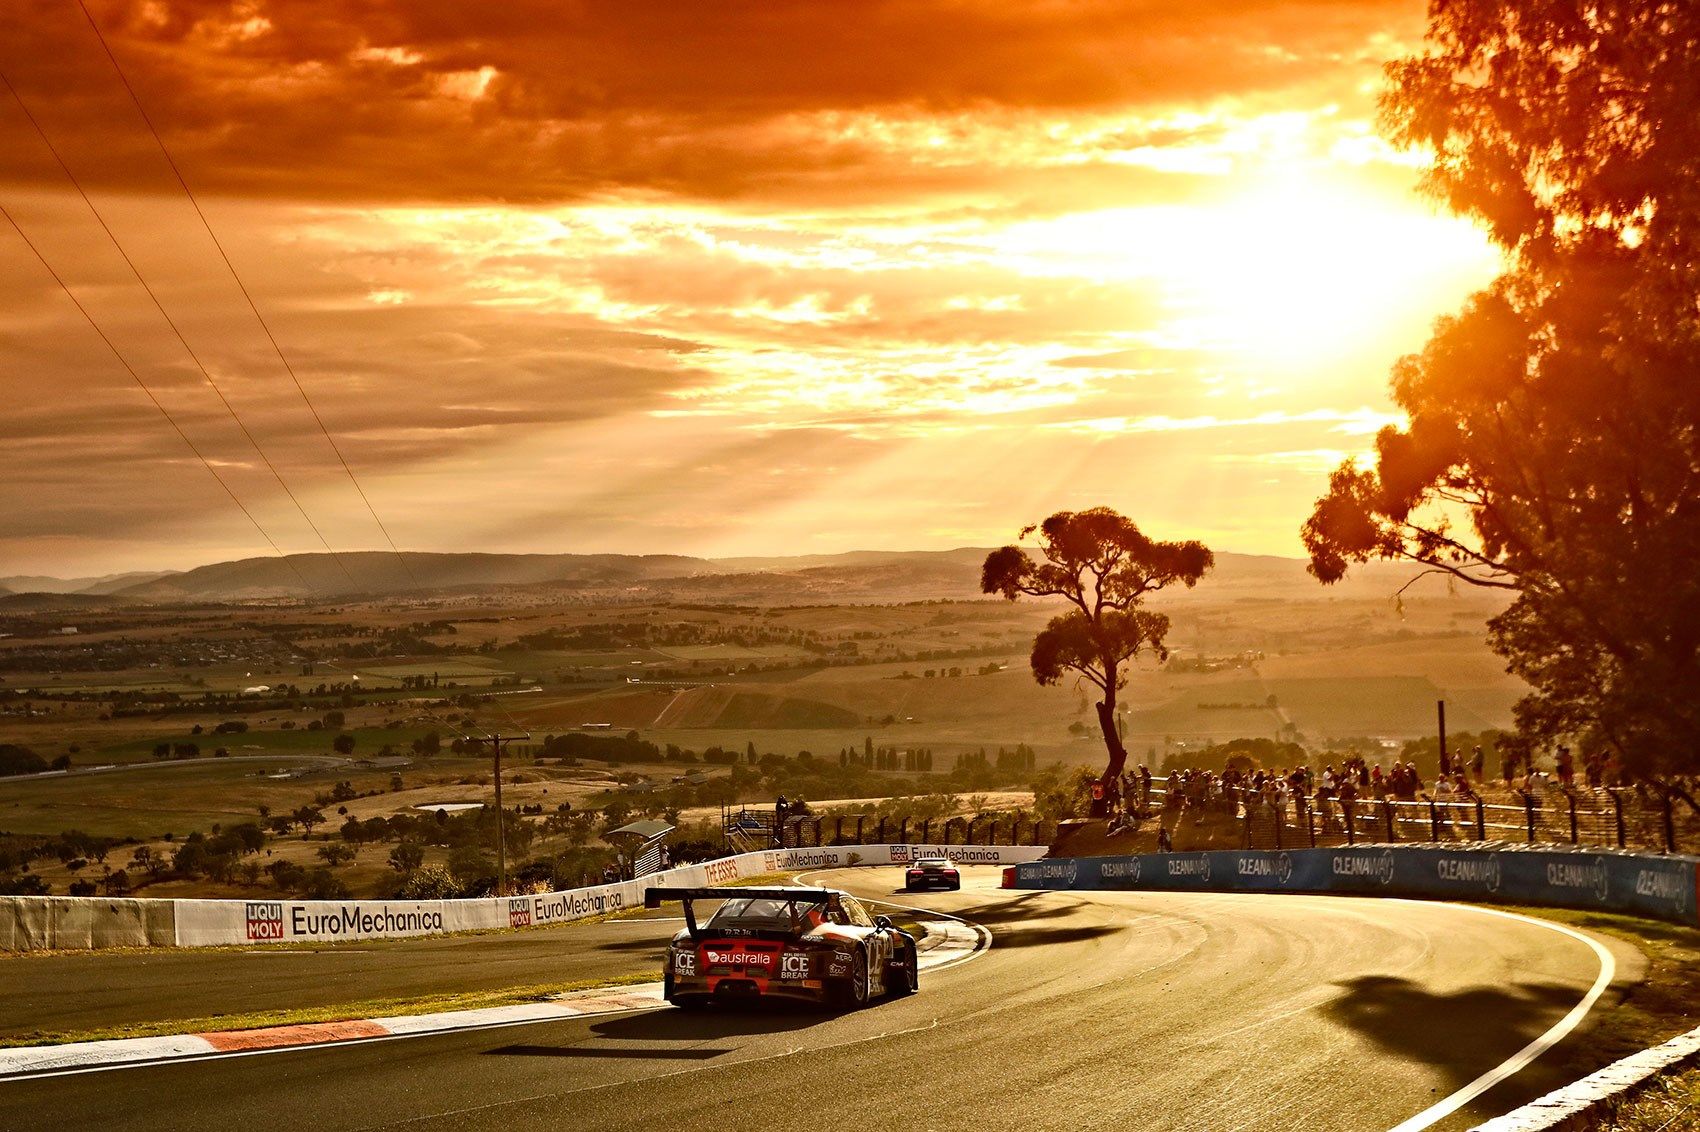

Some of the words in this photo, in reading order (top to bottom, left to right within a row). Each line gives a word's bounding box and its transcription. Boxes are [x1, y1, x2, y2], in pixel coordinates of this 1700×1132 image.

[776, 851, 839, 868] EuroMechanica
[1168, 858, 1211, 876] CLEANAWAY
[1239, 857, 1292, 877] CLEANAWAY
[1333, 855, 1395, 876] CLEANAWAY
[704, 864, 718, 885] THE
[718, 858, 738, 882] ESSES
[1437, 858, 1500, 883] CLEANAWAY
[248, 904, 282, 920] LIQUI
[509, 899, 529, 912] LIQUI
[534, 890, 622, 920] EuroMechanica
[291, 905, 442, 935] EuroMechanica
[510, 912, 531, 926] MOLY
[249, 922, 282, 937] MOLY
[675, 953, 695, 969] ICE
[720, 952, 771, 964] australia
[781, 956, 809, 972] ICE
[781, 971, 809, 979] BREAK
